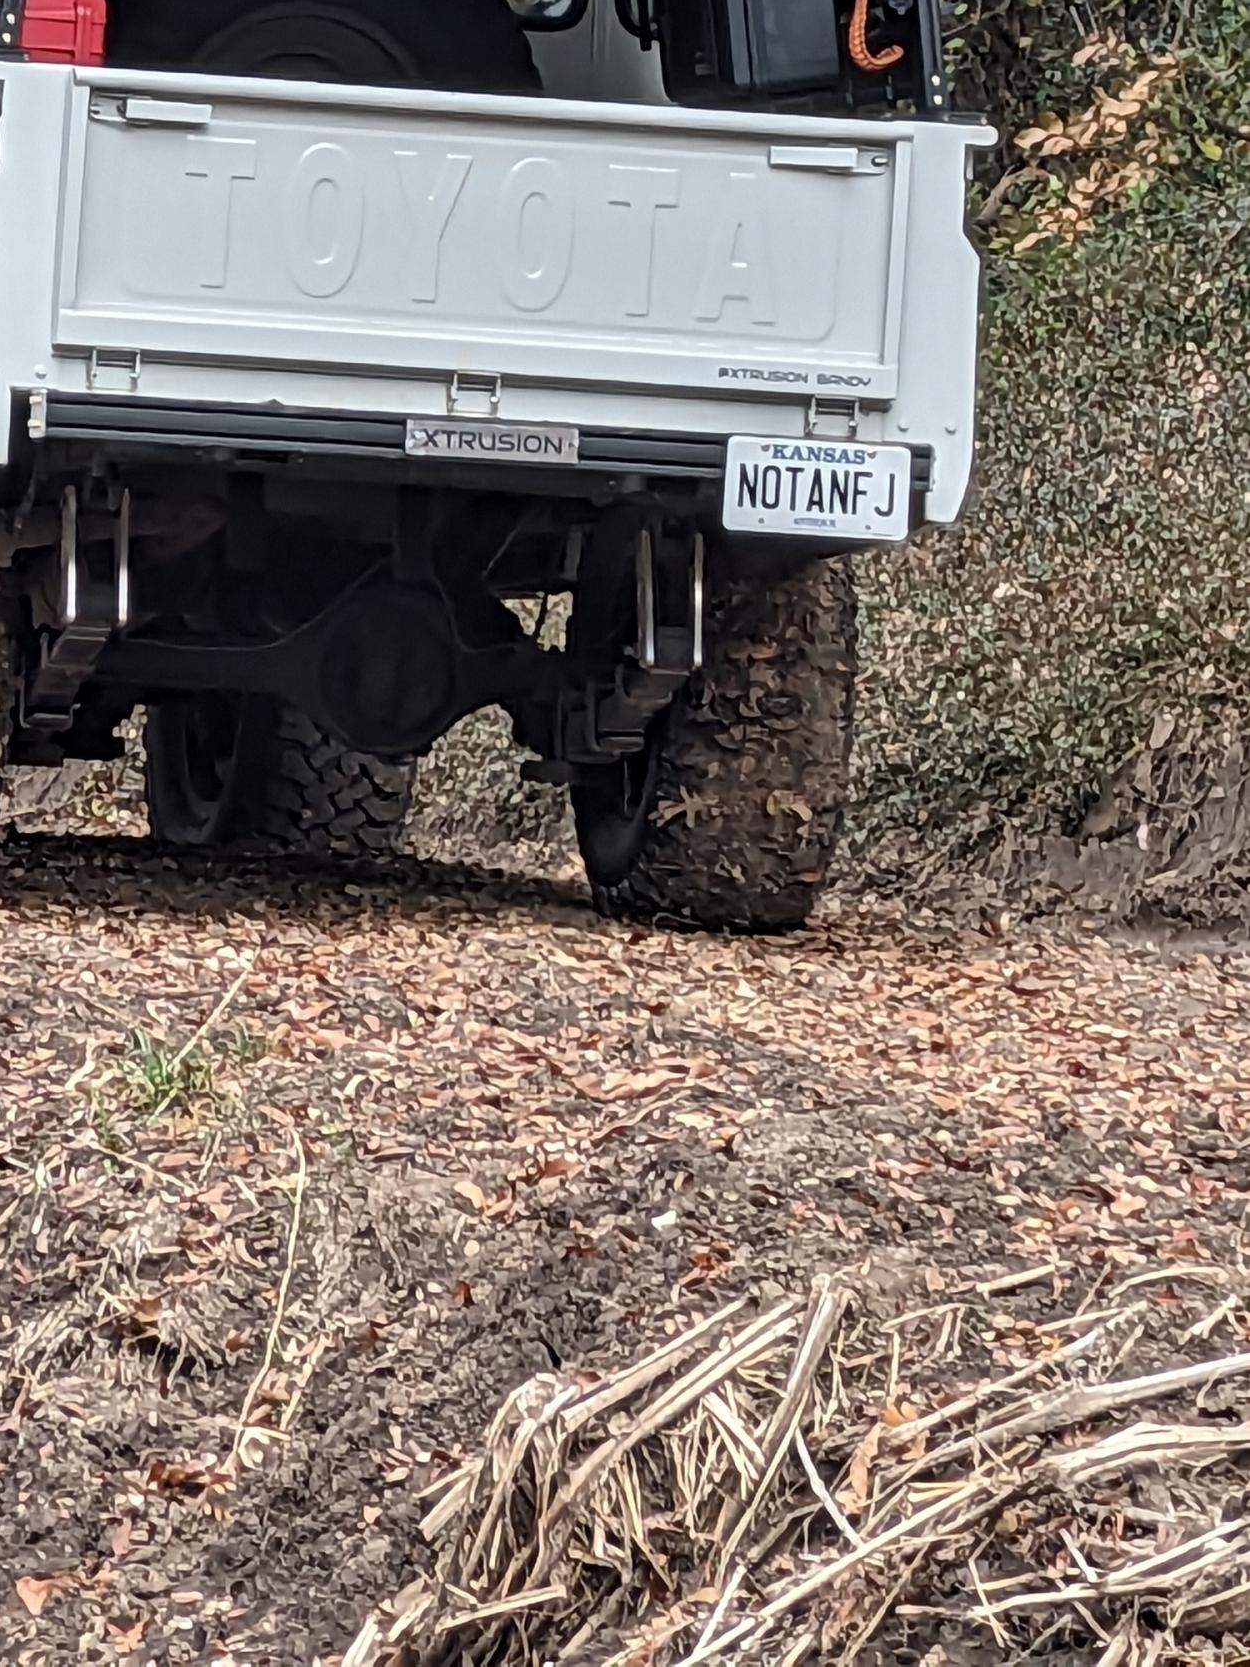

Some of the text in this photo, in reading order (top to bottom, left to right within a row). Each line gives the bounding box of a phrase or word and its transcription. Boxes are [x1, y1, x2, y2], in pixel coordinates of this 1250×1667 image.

[184, 135, 776, 325] TOYOTA
[423, 428, 563, 455] XTRUSION
[771, 444, 867, 465] KANSAS
[737, 462, 896, 518] NOTANFJ
